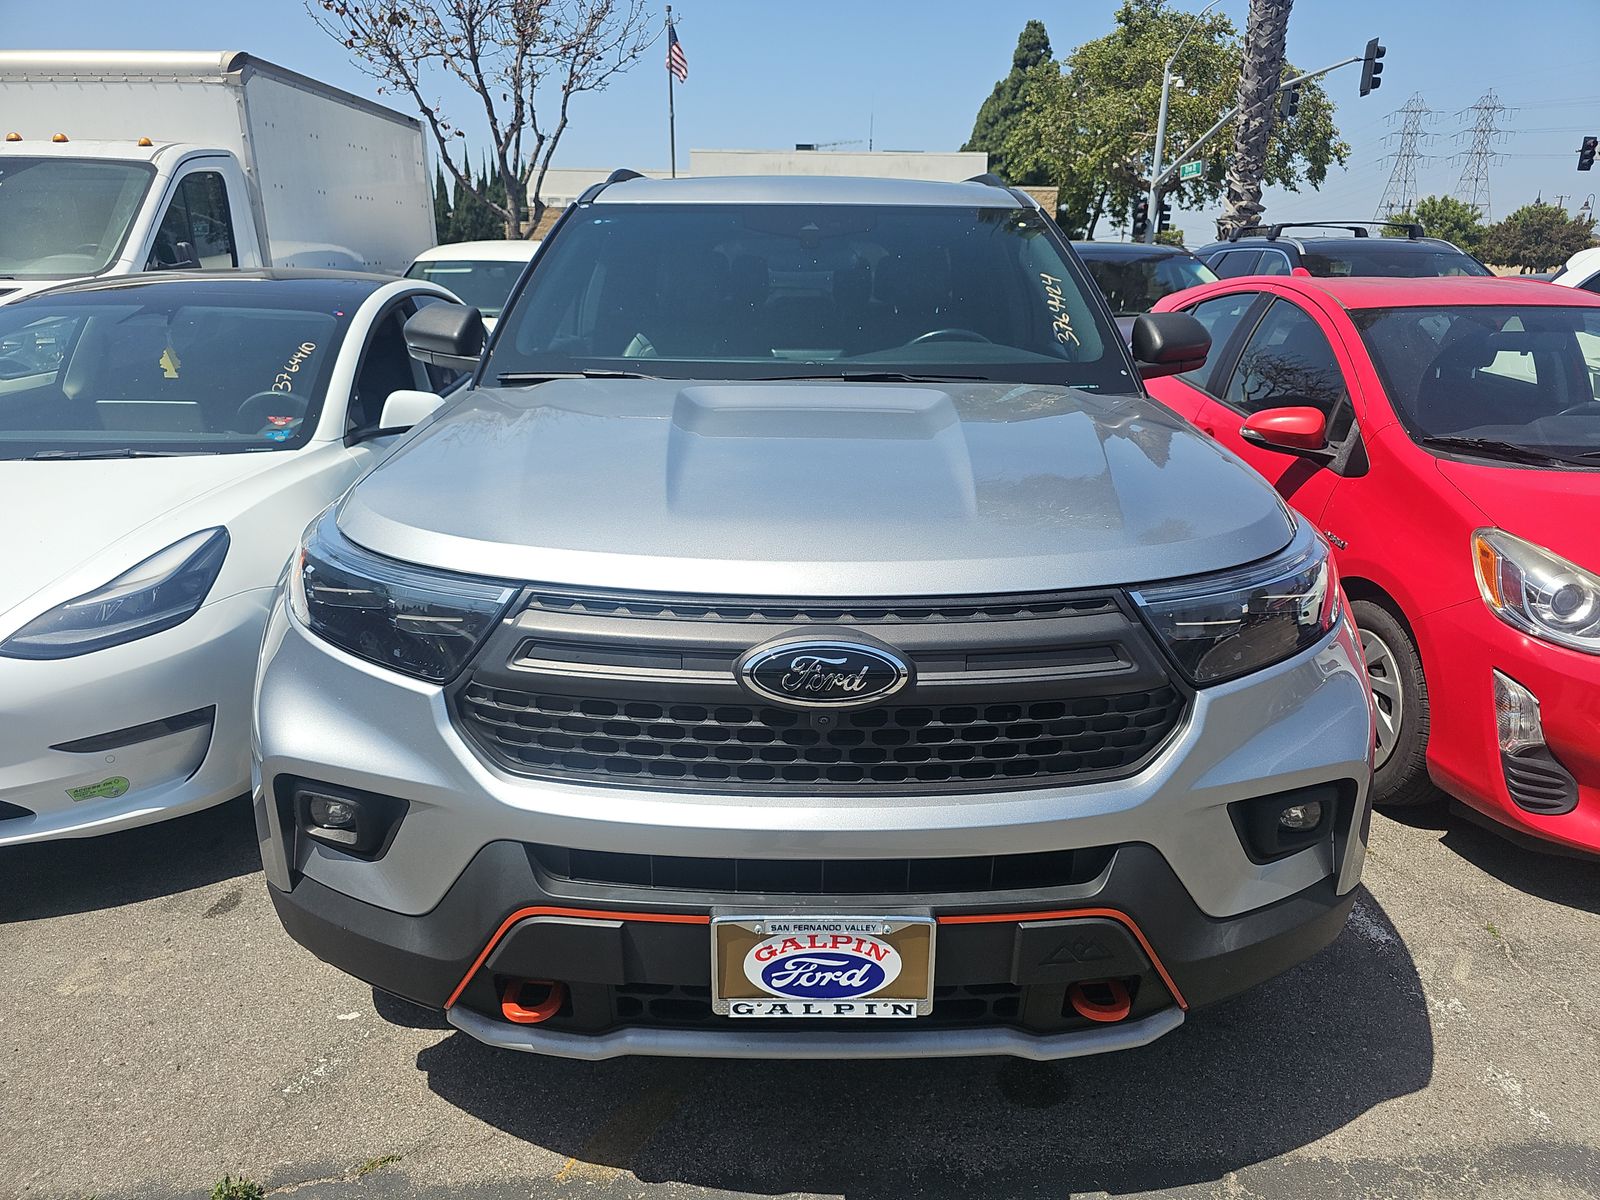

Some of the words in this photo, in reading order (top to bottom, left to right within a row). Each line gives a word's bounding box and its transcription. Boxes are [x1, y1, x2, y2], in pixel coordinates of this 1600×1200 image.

[271, 341, 317, 393] 3764410
[781, 655, 869, 692] Ford
[770, 923, 790, 932] SAN
[793, 923, 842, 932] FERNANDO
[845, 923, 877, 932] VALLEY
[754, 934, 891, 962] GALPIN
[771, 957, 872, 988] Ford
[732, 1002, 914, 1015] GALPIN
